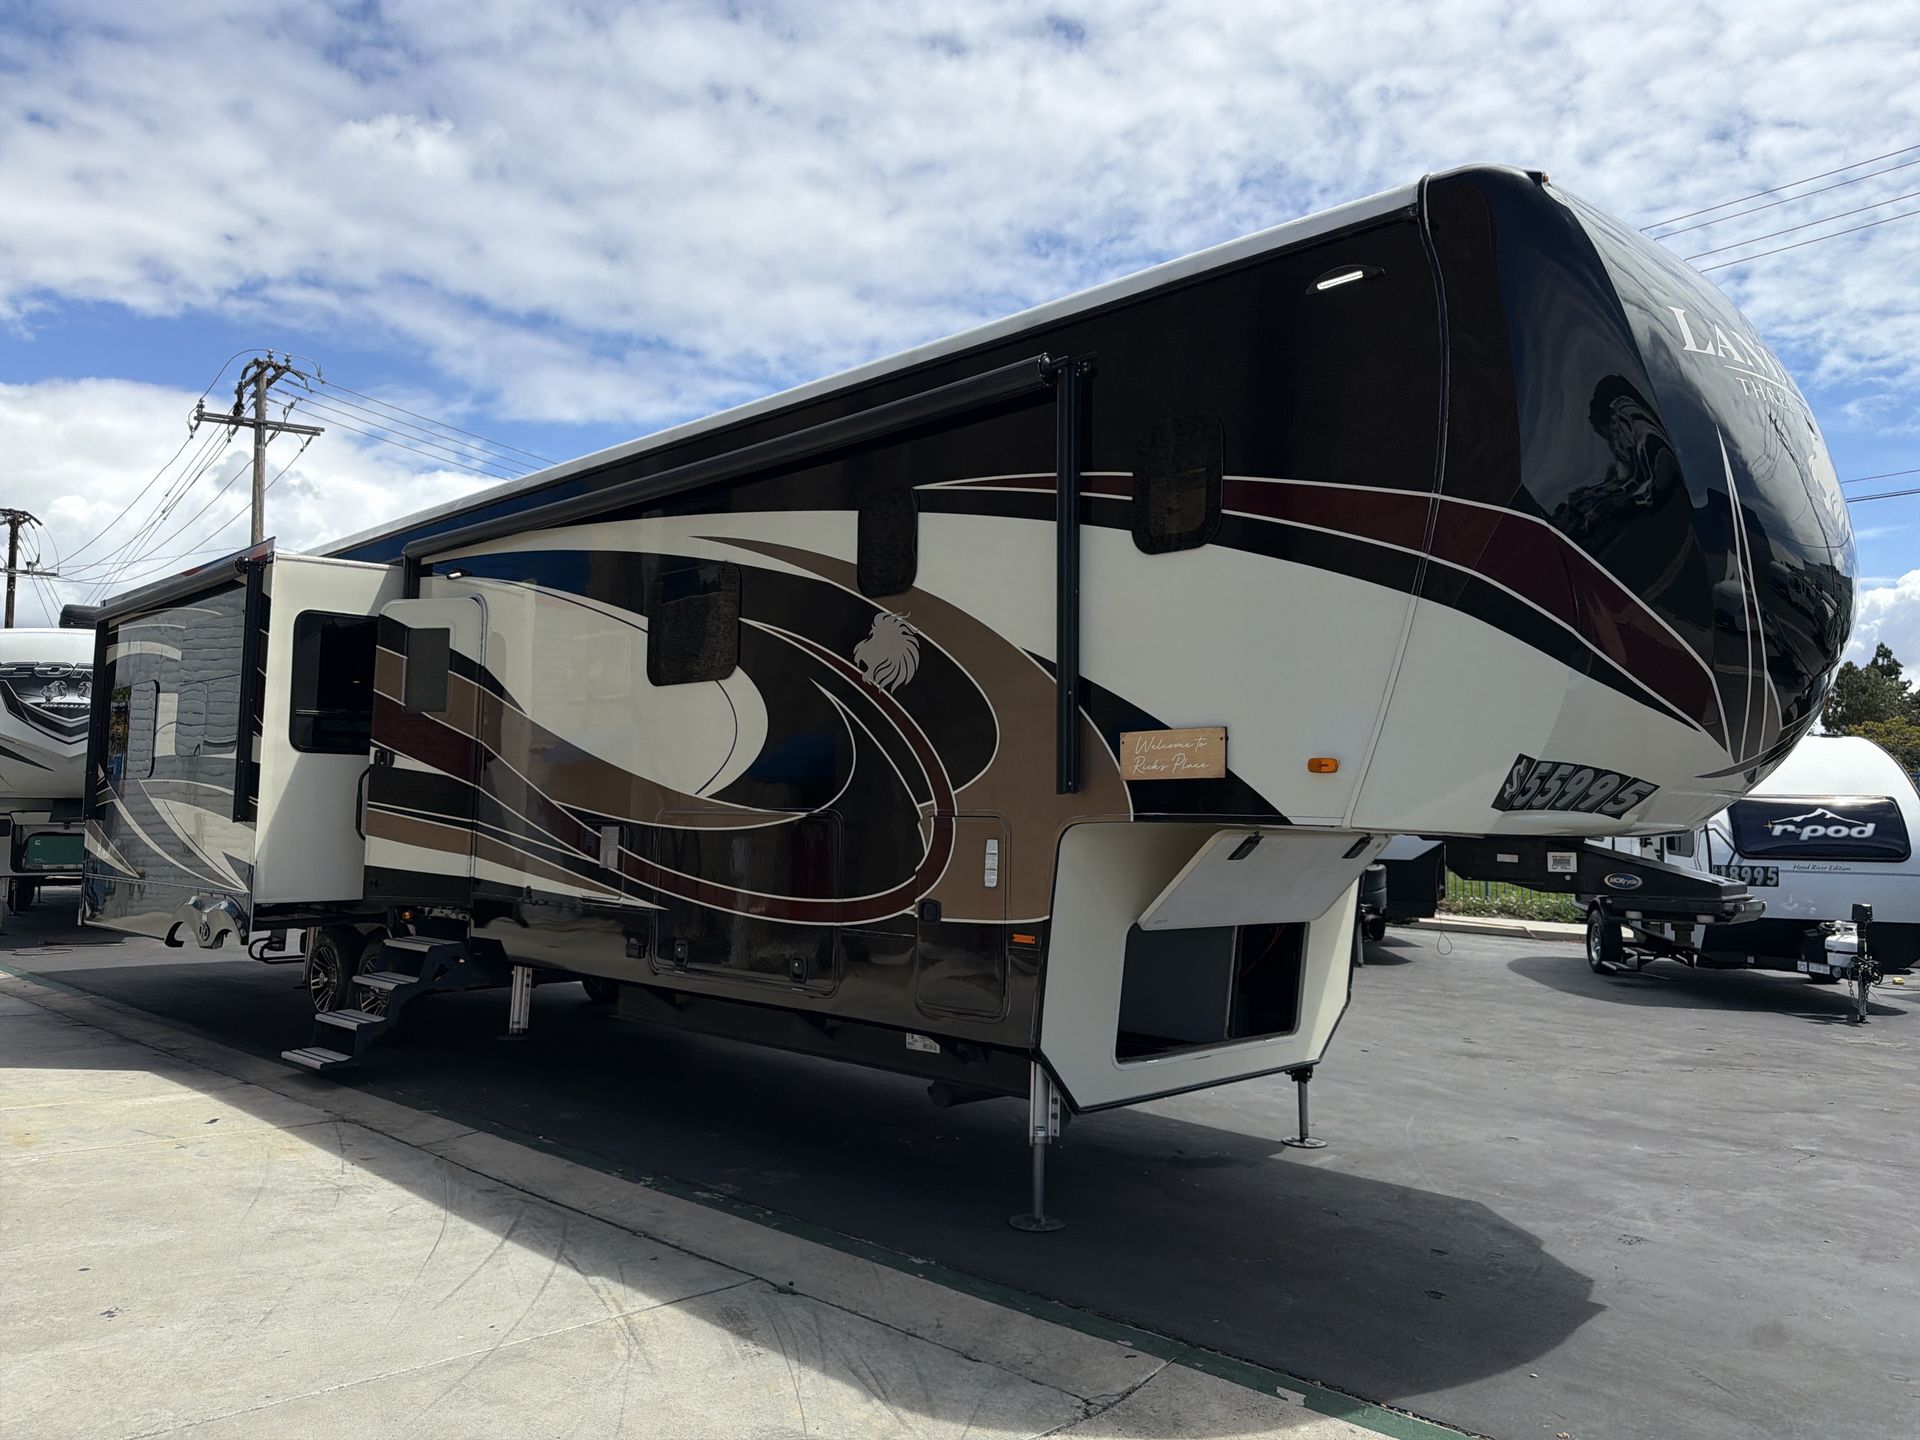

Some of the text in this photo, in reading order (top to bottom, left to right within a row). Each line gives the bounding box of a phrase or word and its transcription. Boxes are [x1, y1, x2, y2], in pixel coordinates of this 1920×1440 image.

[1135, 735, 1208, 754] Welcome to
[1172, 753, 1210, 774] Place
[1503, 758, 1656, 814] $55995
[1793, 863, 1810, 871] Hood
[1828, 864, 1851, 872] Edition
